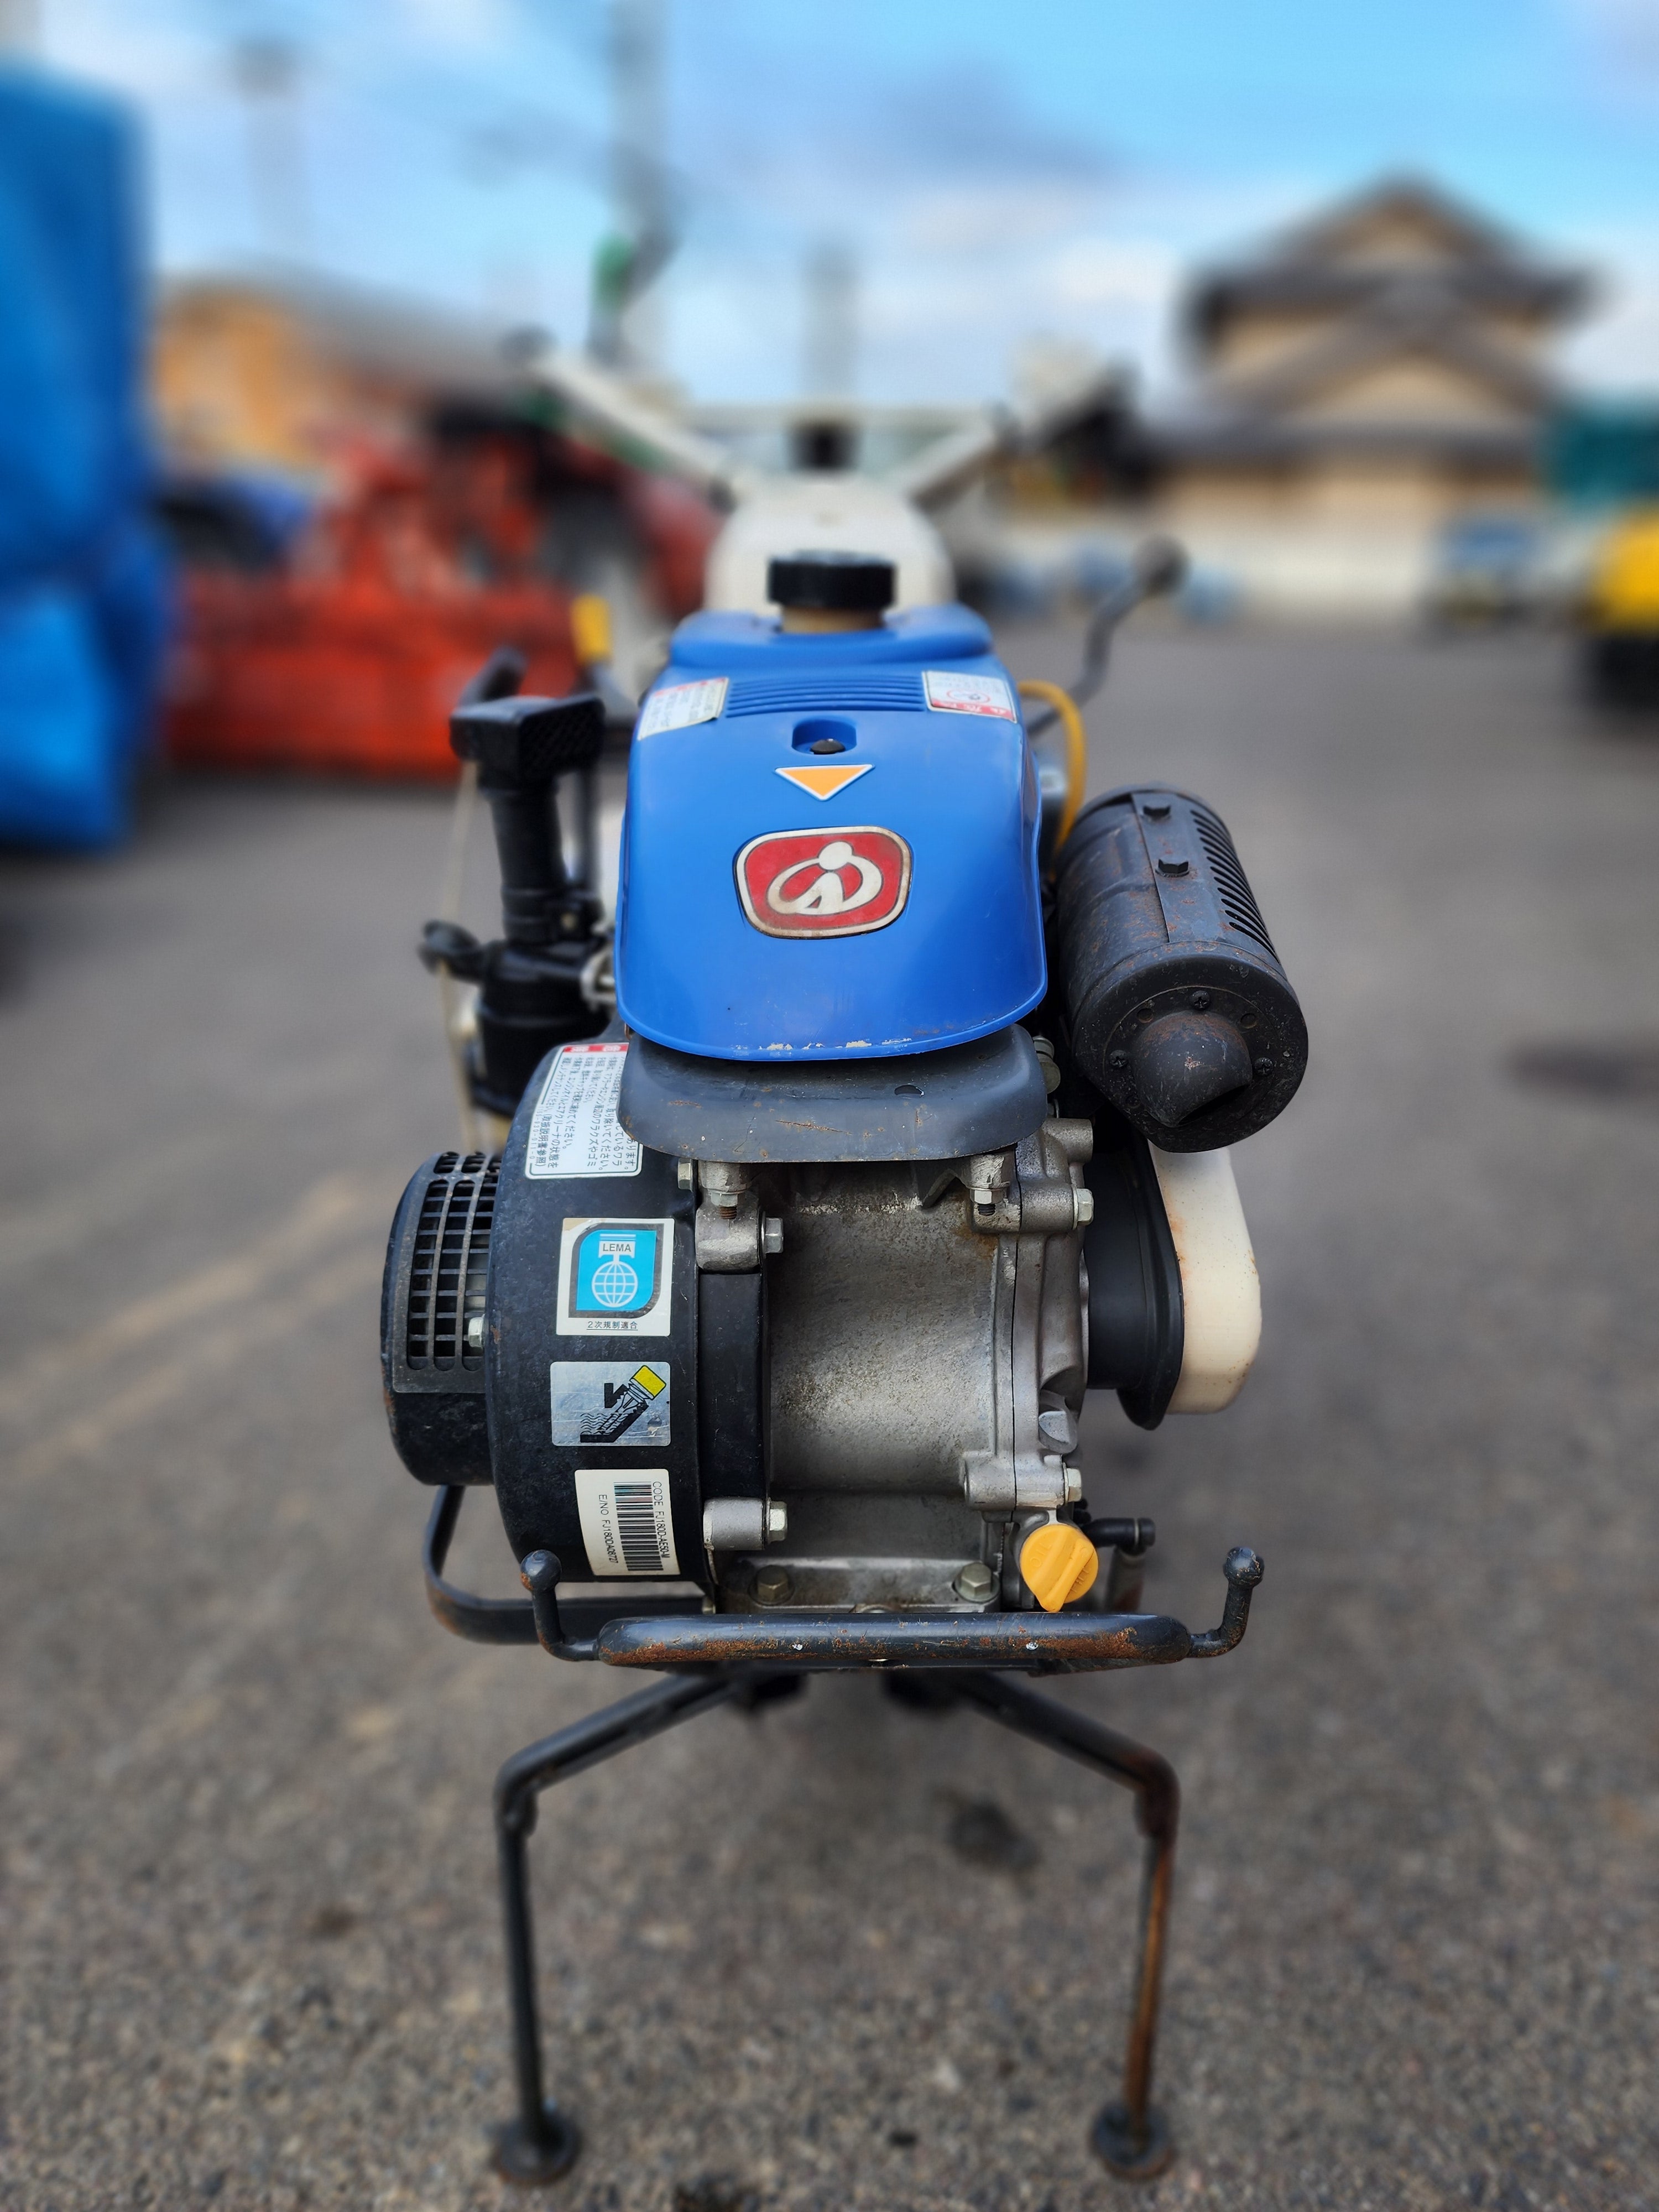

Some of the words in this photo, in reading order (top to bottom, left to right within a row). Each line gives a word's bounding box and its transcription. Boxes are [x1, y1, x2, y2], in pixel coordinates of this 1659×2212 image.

[602, 1243, 632, 1252] LEMA
[587, 1321, 638, 1329] 2次規制適合
[653, 1481, 664, 1506] CODE
[598, 1495, 609, 1515] E/NO
[1030, 1542, 1052, 1568] OIL
